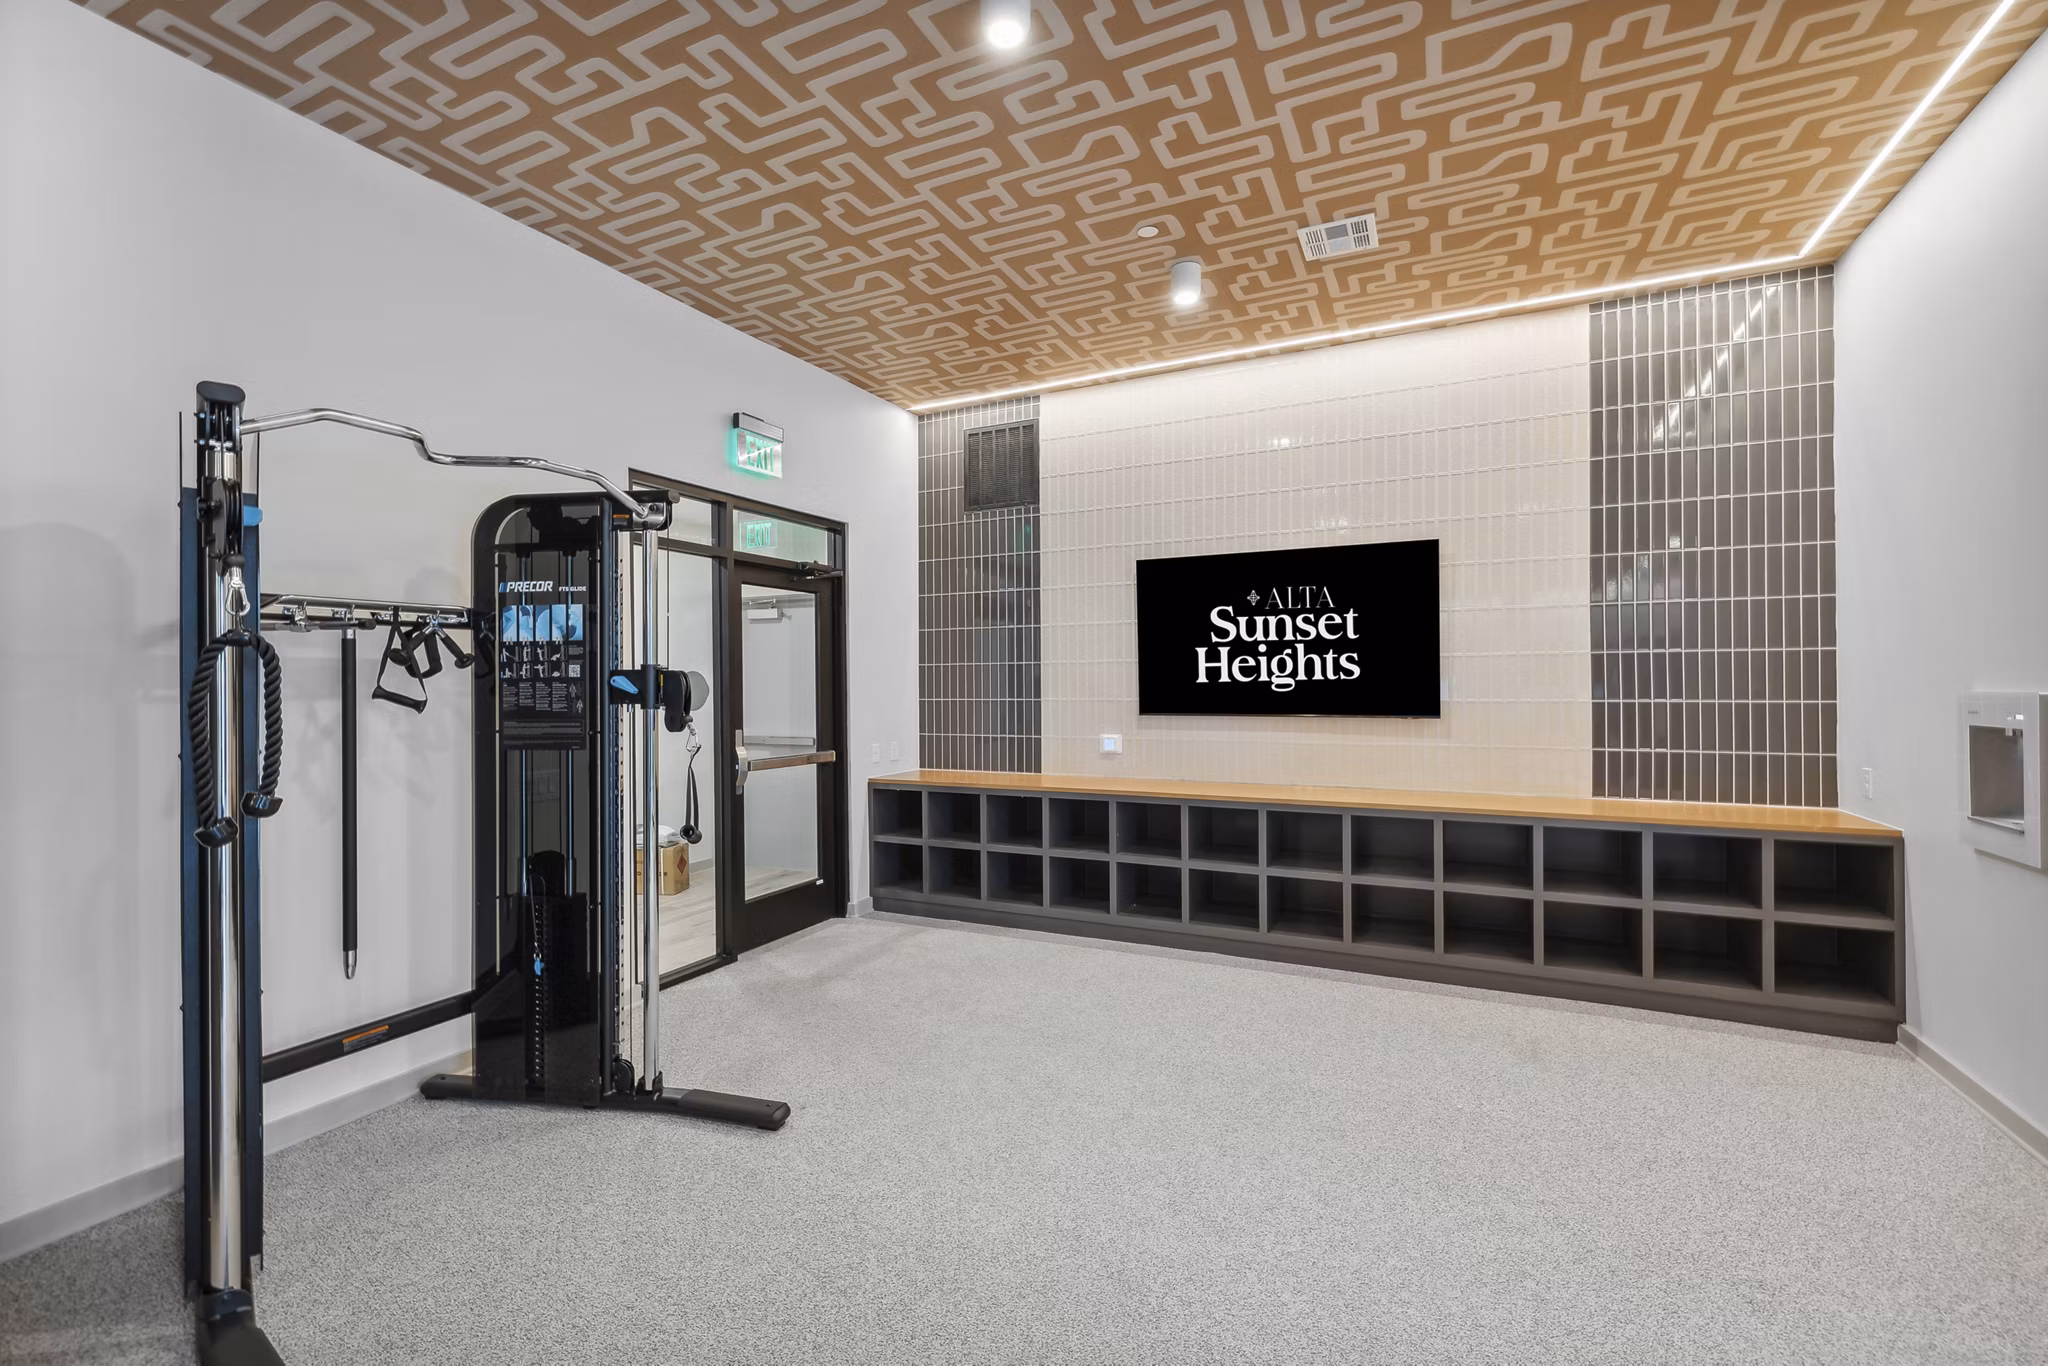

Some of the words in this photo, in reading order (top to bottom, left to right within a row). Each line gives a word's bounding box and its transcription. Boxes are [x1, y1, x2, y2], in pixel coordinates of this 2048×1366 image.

[746, 435, 774, 472] EXIT
[747, 522, 772, 548] EXIT
[506, 581, 553, 592] PRECOR
[1264, 586, 1335, 609] ALTA
[1210, 606, 1359, 642] Sunset
[1195, 643, 1360, 692] Heights
